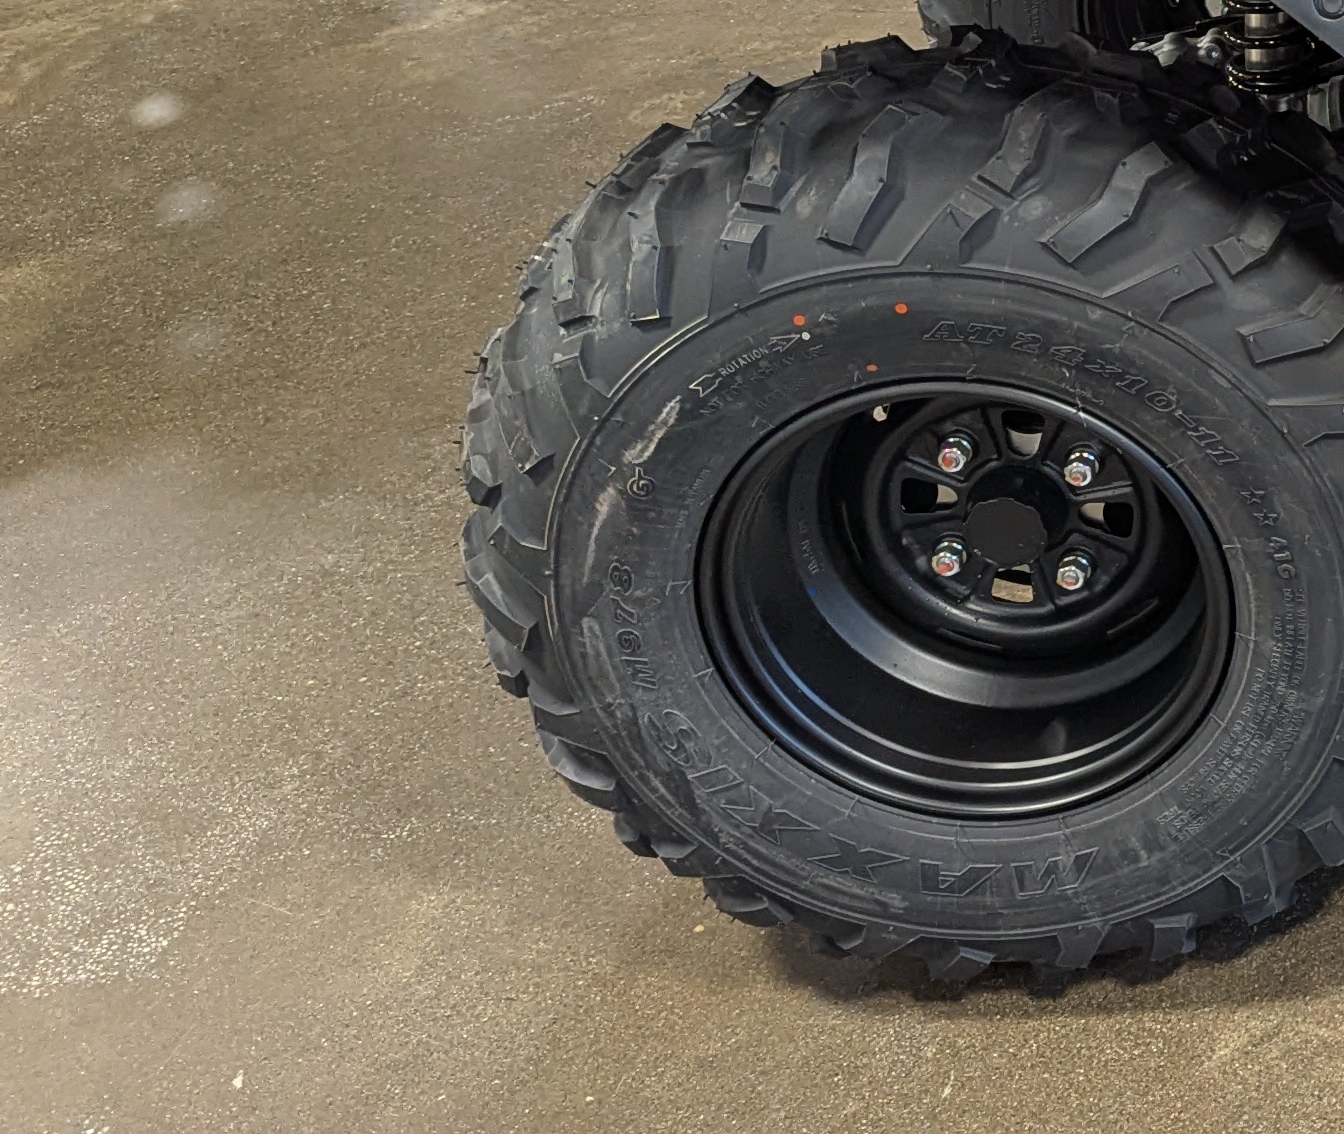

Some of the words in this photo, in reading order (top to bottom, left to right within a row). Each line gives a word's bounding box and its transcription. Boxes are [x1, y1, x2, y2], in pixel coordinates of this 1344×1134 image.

[718, 344, 769, 377] ROTATION
[923, 320, 1007, 345] AT
[608, 562, 658, 690] M978
[646, 708, 1100, 900] MAXXIS
